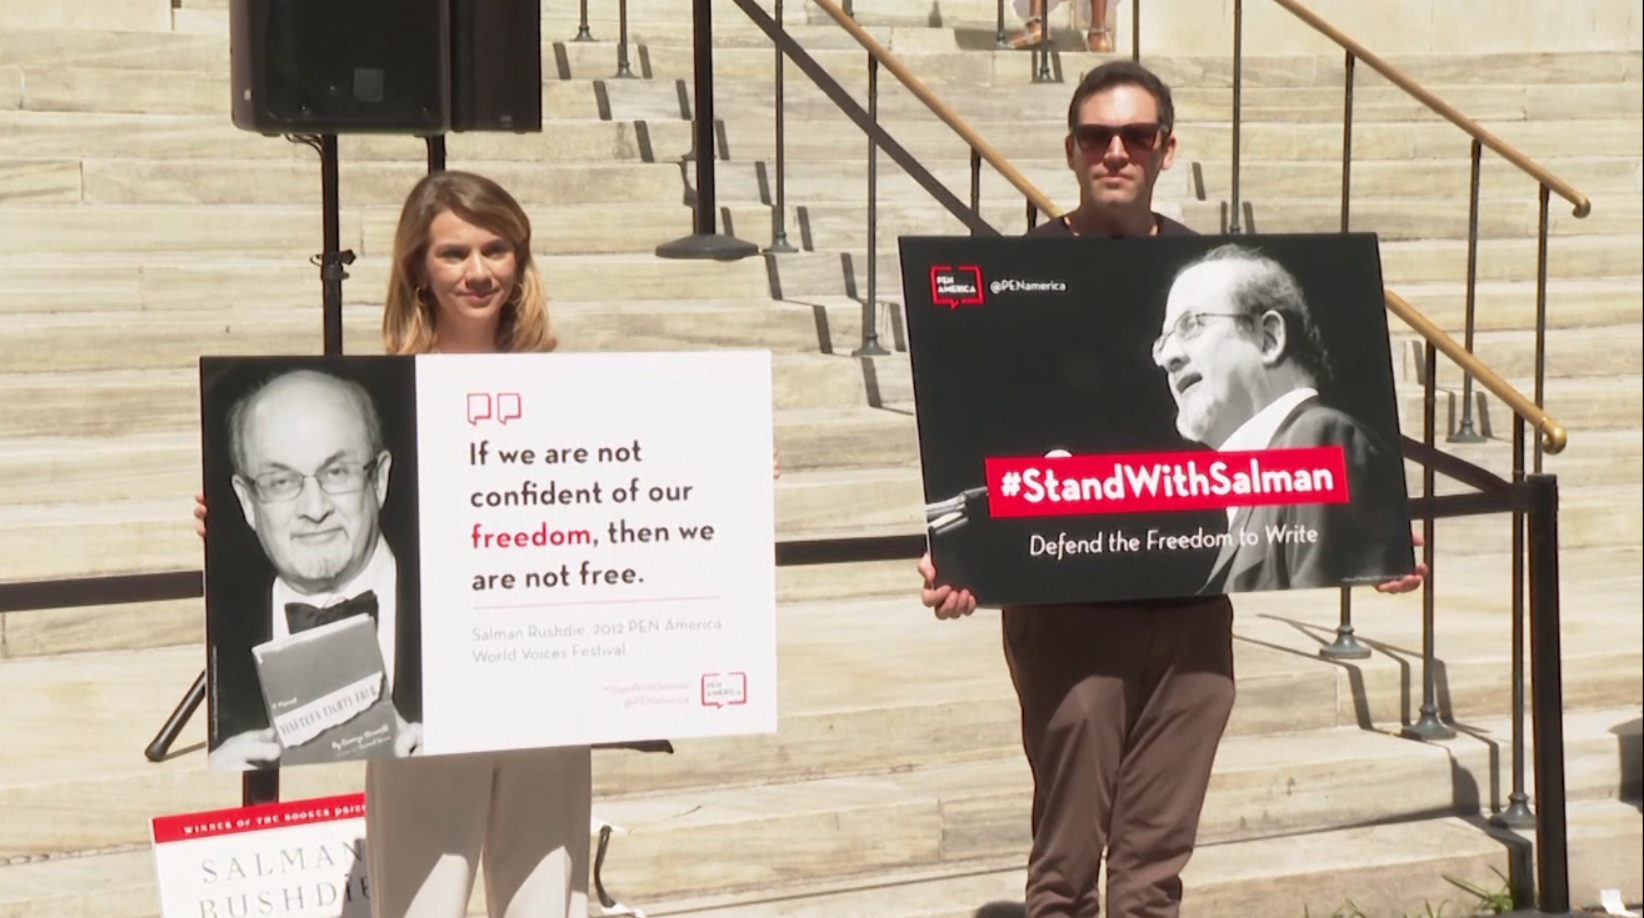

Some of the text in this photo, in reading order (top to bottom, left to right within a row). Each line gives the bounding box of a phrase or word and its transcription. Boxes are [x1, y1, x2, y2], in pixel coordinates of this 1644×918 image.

[936, 276, 954, 285] PEN
[937, 284, 977, 294] AMERICA
[989, 279, 1067, 295] @PENamerica
[469, 440, 643, 466] If we are not
[469, 477, 694, 508] confident of our
[1000, 458, 1334, 503] #StandWithSalman
[471, 519, 715, 549] freedom, then we
[1029, 522, 1320, 561] Defend the Freedom to Write
[471, 560, 645, 591] are not free.
[472, 627, 524, 642] Salman
[592, 623, 625, 637] 2012
[627, 618, 661, 633] PEN
[663, 617, 723, 632] America
[472, 642, 627, 663] World Voices Festival
[201, 841, 364, 883] SALMAN
